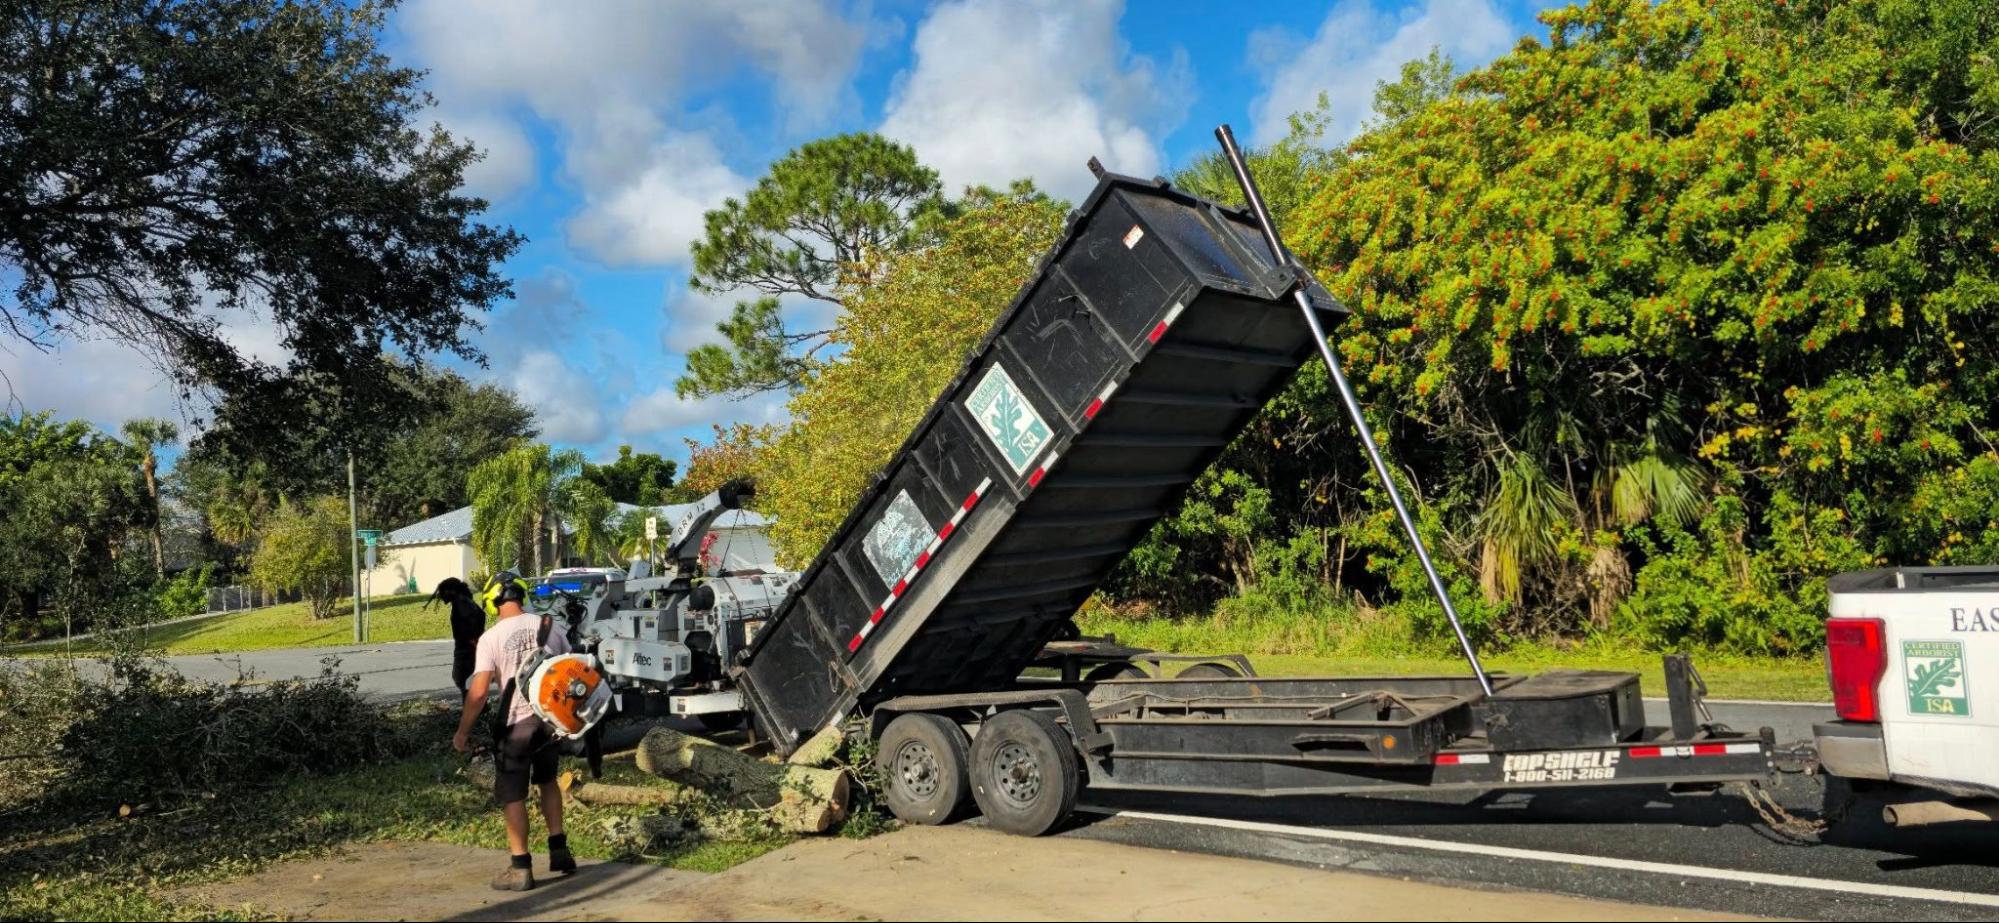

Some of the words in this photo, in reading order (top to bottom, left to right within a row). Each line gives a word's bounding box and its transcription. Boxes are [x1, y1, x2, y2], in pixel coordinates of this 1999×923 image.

[1018, 430, 1040, 457] ISA
[1950, 607, 1999, 632] EAS
[1904, 642, 1960, 650] CERTIFIED
[1907, 649, 1958, 657] ARBORIST
[632, 652, 652, 666] Altec
[1924, 698, 1955, 713] ISA
